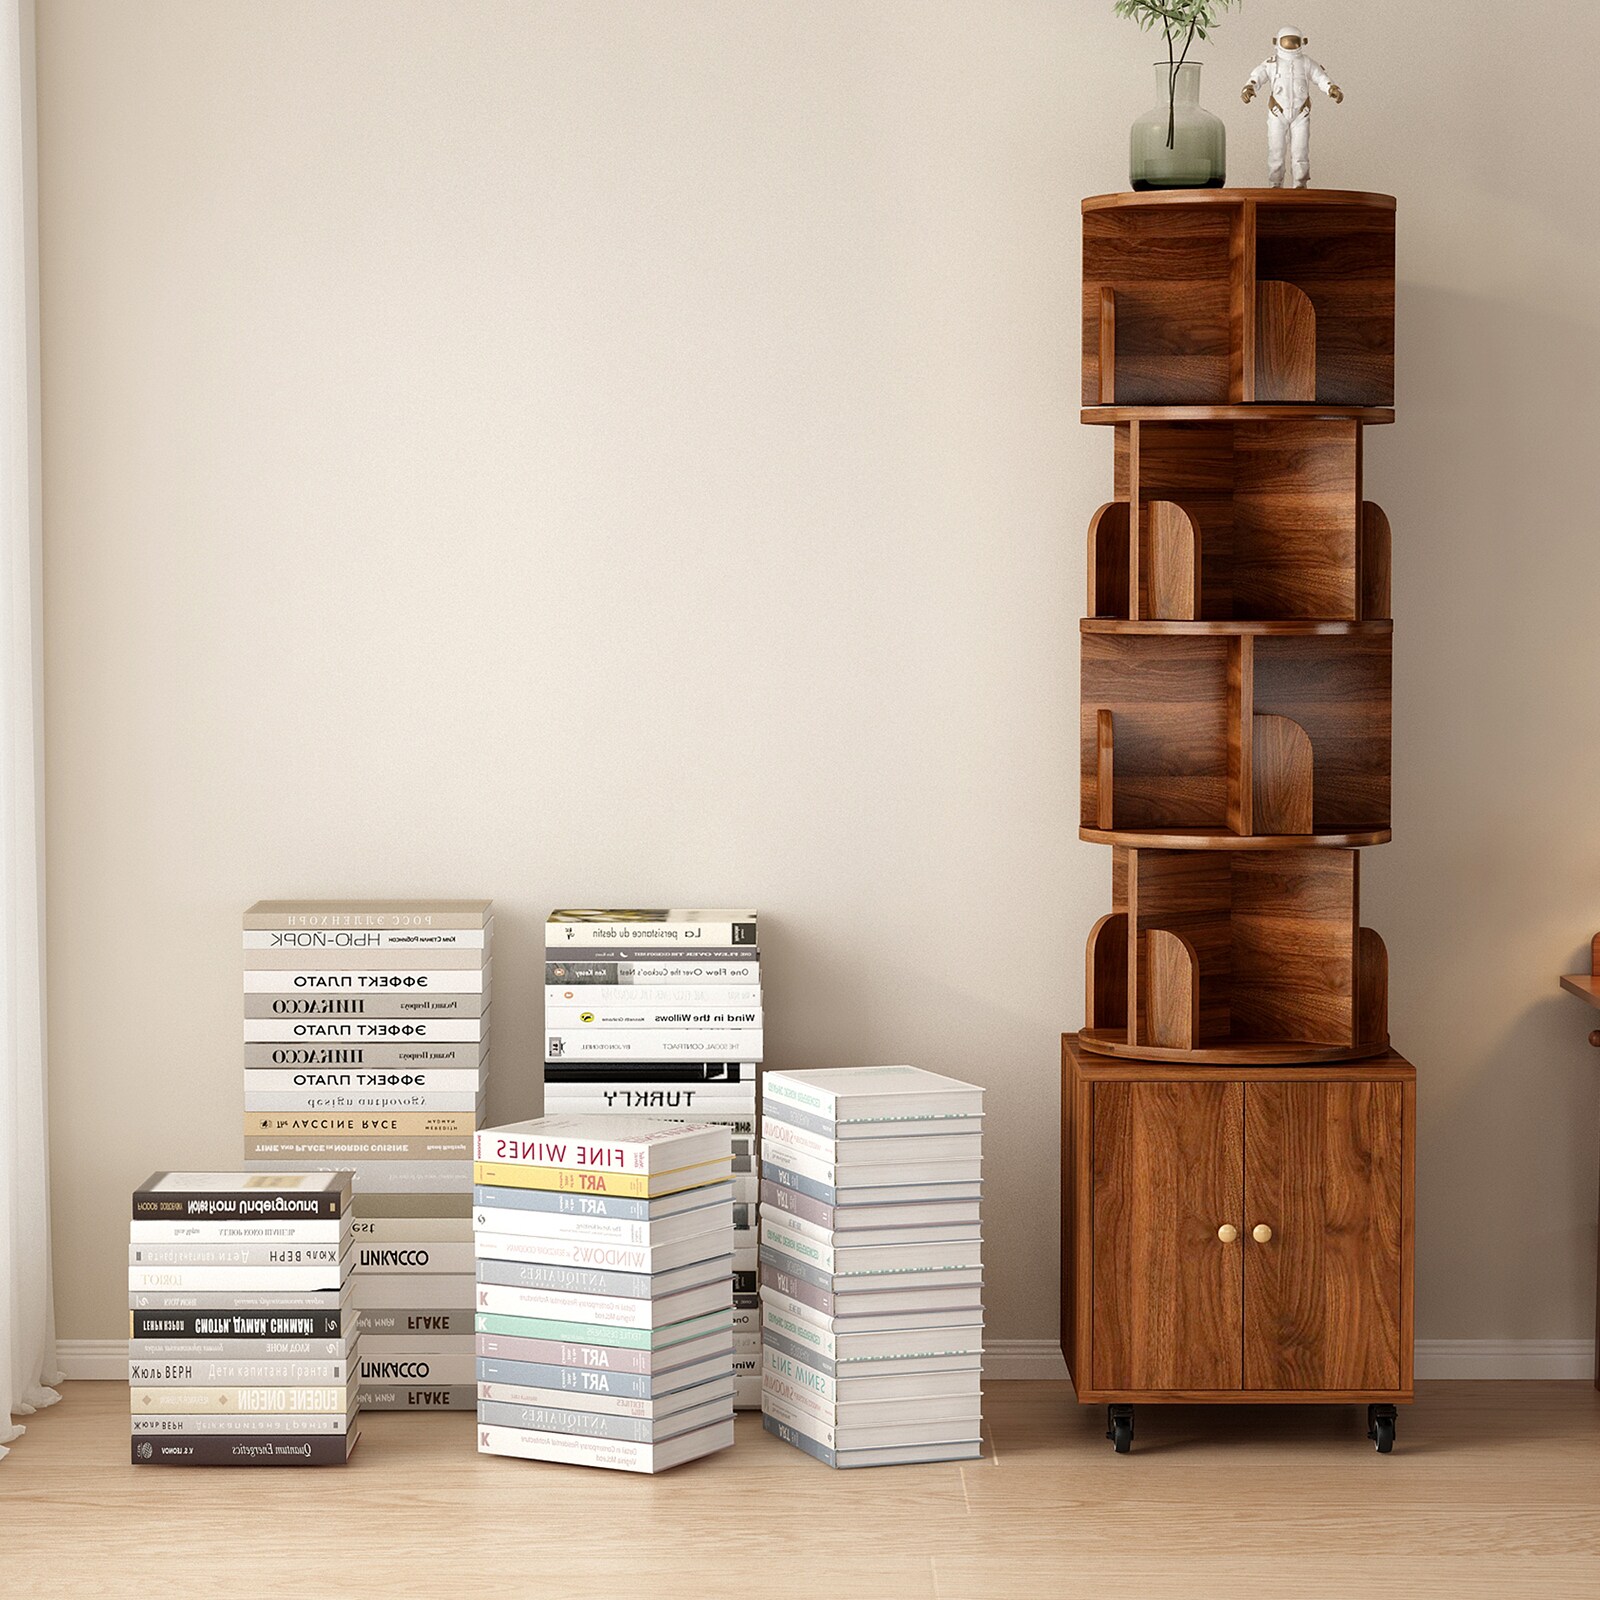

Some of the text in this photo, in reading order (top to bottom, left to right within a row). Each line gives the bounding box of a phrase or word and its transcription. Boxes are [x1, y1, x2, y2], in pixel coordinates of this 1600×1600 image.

[479, 1292, 488, 1306] K
[478, 1317, 488, 1331] K
[132, 1365, 192, 1379] Жюль ВЕРН
[209, 1364, 234, 1379] Дети
[238, 1368, 288, 1377] капитана
[481, 1432, 490, 1446] K
